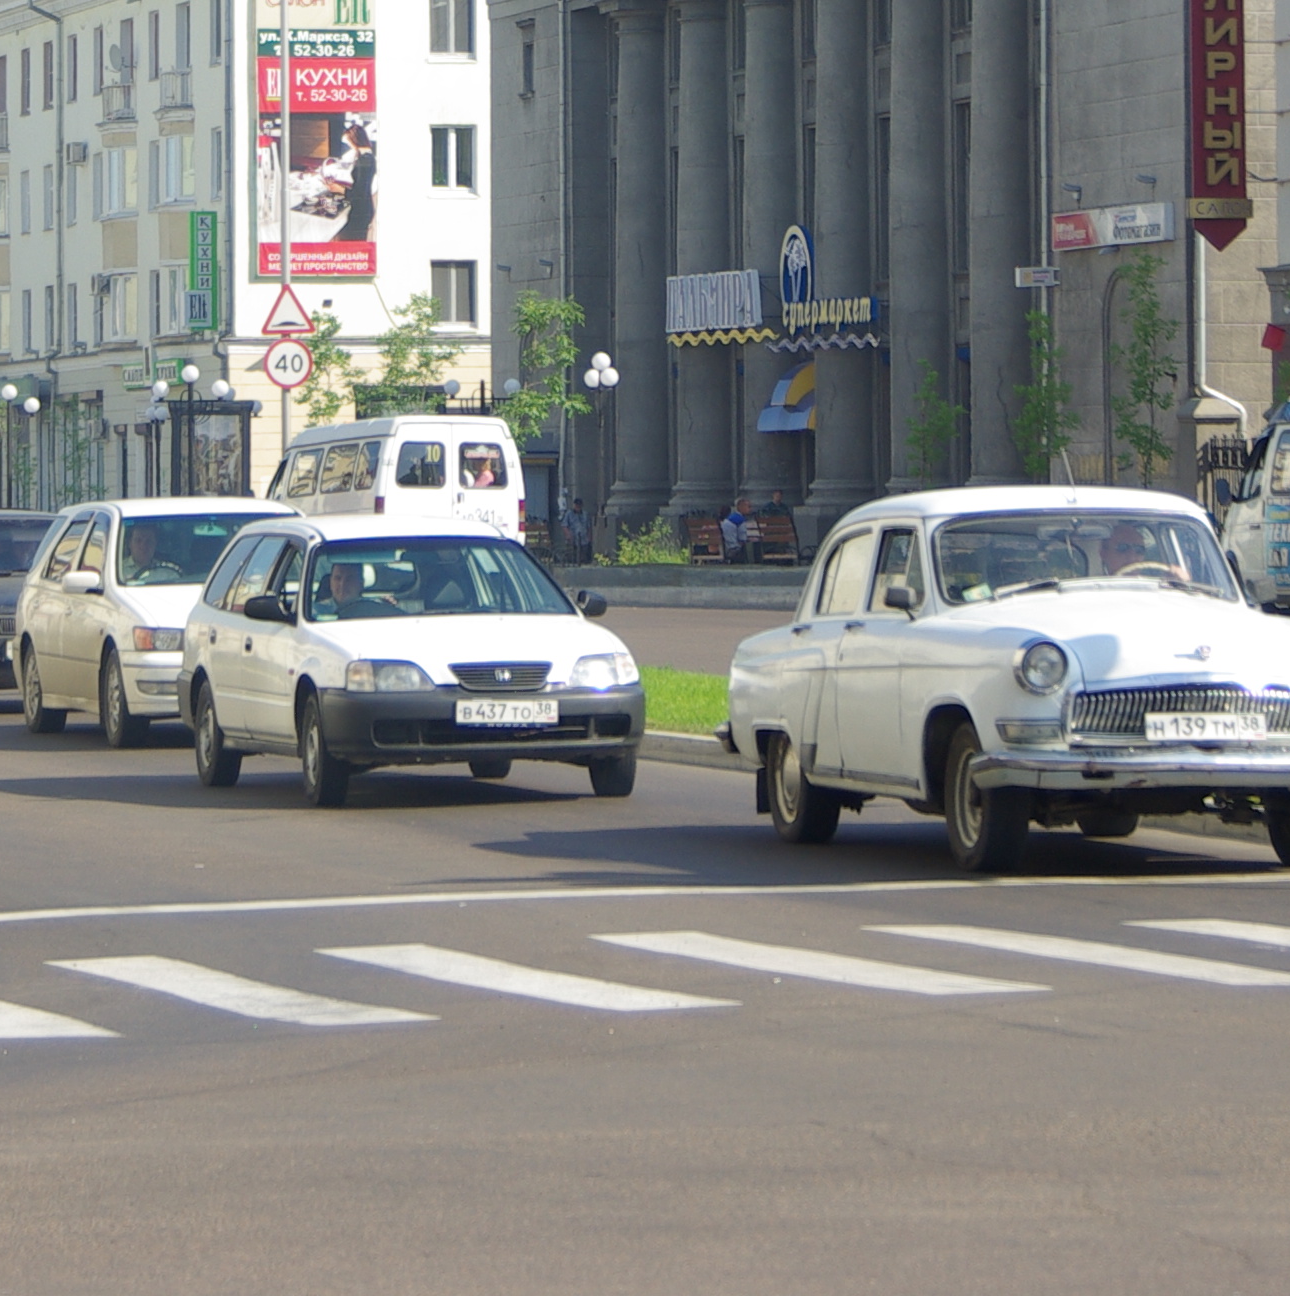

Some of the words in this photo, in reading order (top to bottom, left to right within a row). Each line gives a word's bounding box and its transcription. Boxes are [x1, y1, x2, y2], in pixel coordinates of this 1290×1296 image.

[356, 31, 374, 42] 32
[293, 44, 355, 57] 52-30-26
[295, 68, 367, 86] КУХНИ
[310, 89, 368, 102] 52-30-26
[199, 216, 210, 288] КУХНИ
[268, 252, 334, 262] СОРШЕННЫЙ
[666, 269, 763, 333] ПАЛЬМИРА
[782, 297, 872, 336] супермаркет
[274, 353, 304, 373] 40
[425, 444, 441, 463] 10
